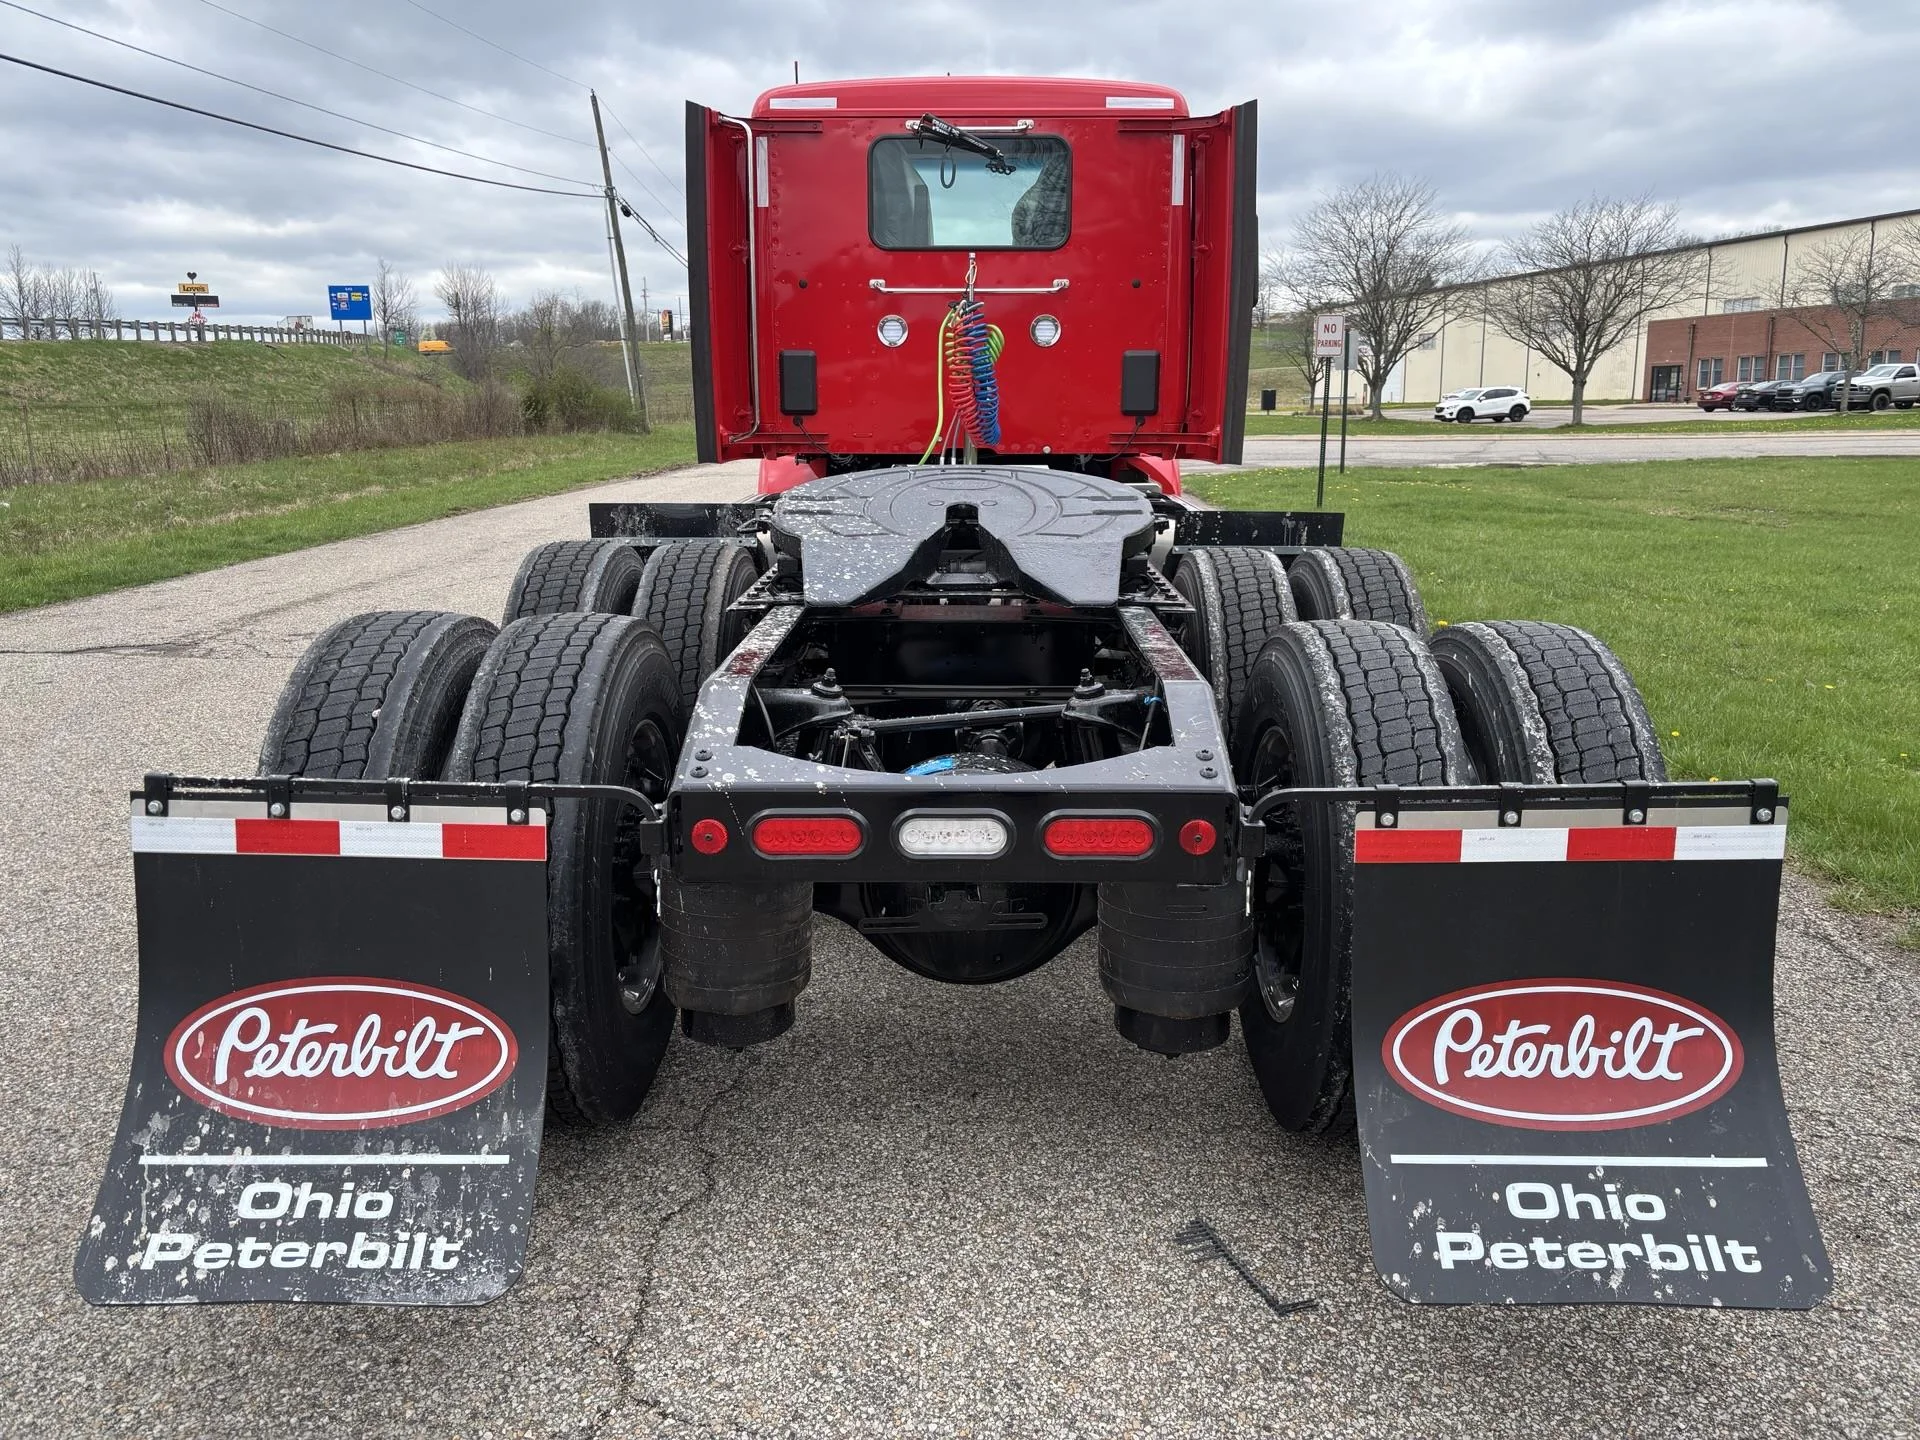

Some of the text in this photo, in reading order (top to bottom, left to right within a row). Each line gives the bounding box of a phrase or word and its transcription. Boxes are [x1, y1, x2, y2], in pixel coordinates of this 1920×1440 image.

[1317, 339, 1342, 348] PARKING
[1323, 323, 1337, 334] NO
[215, 1006, 483, 1085] Peterbilt
[1434, 1008, 1705, 1085] Peterbilt
[237, 1181, 394, 1220] Ohio
[1506, 1182, 1666, 1221] Ohio
[141, 1232, 463, 1271] Peterbilt
[1436, 1232, 1763, 1274] Peterbilt
